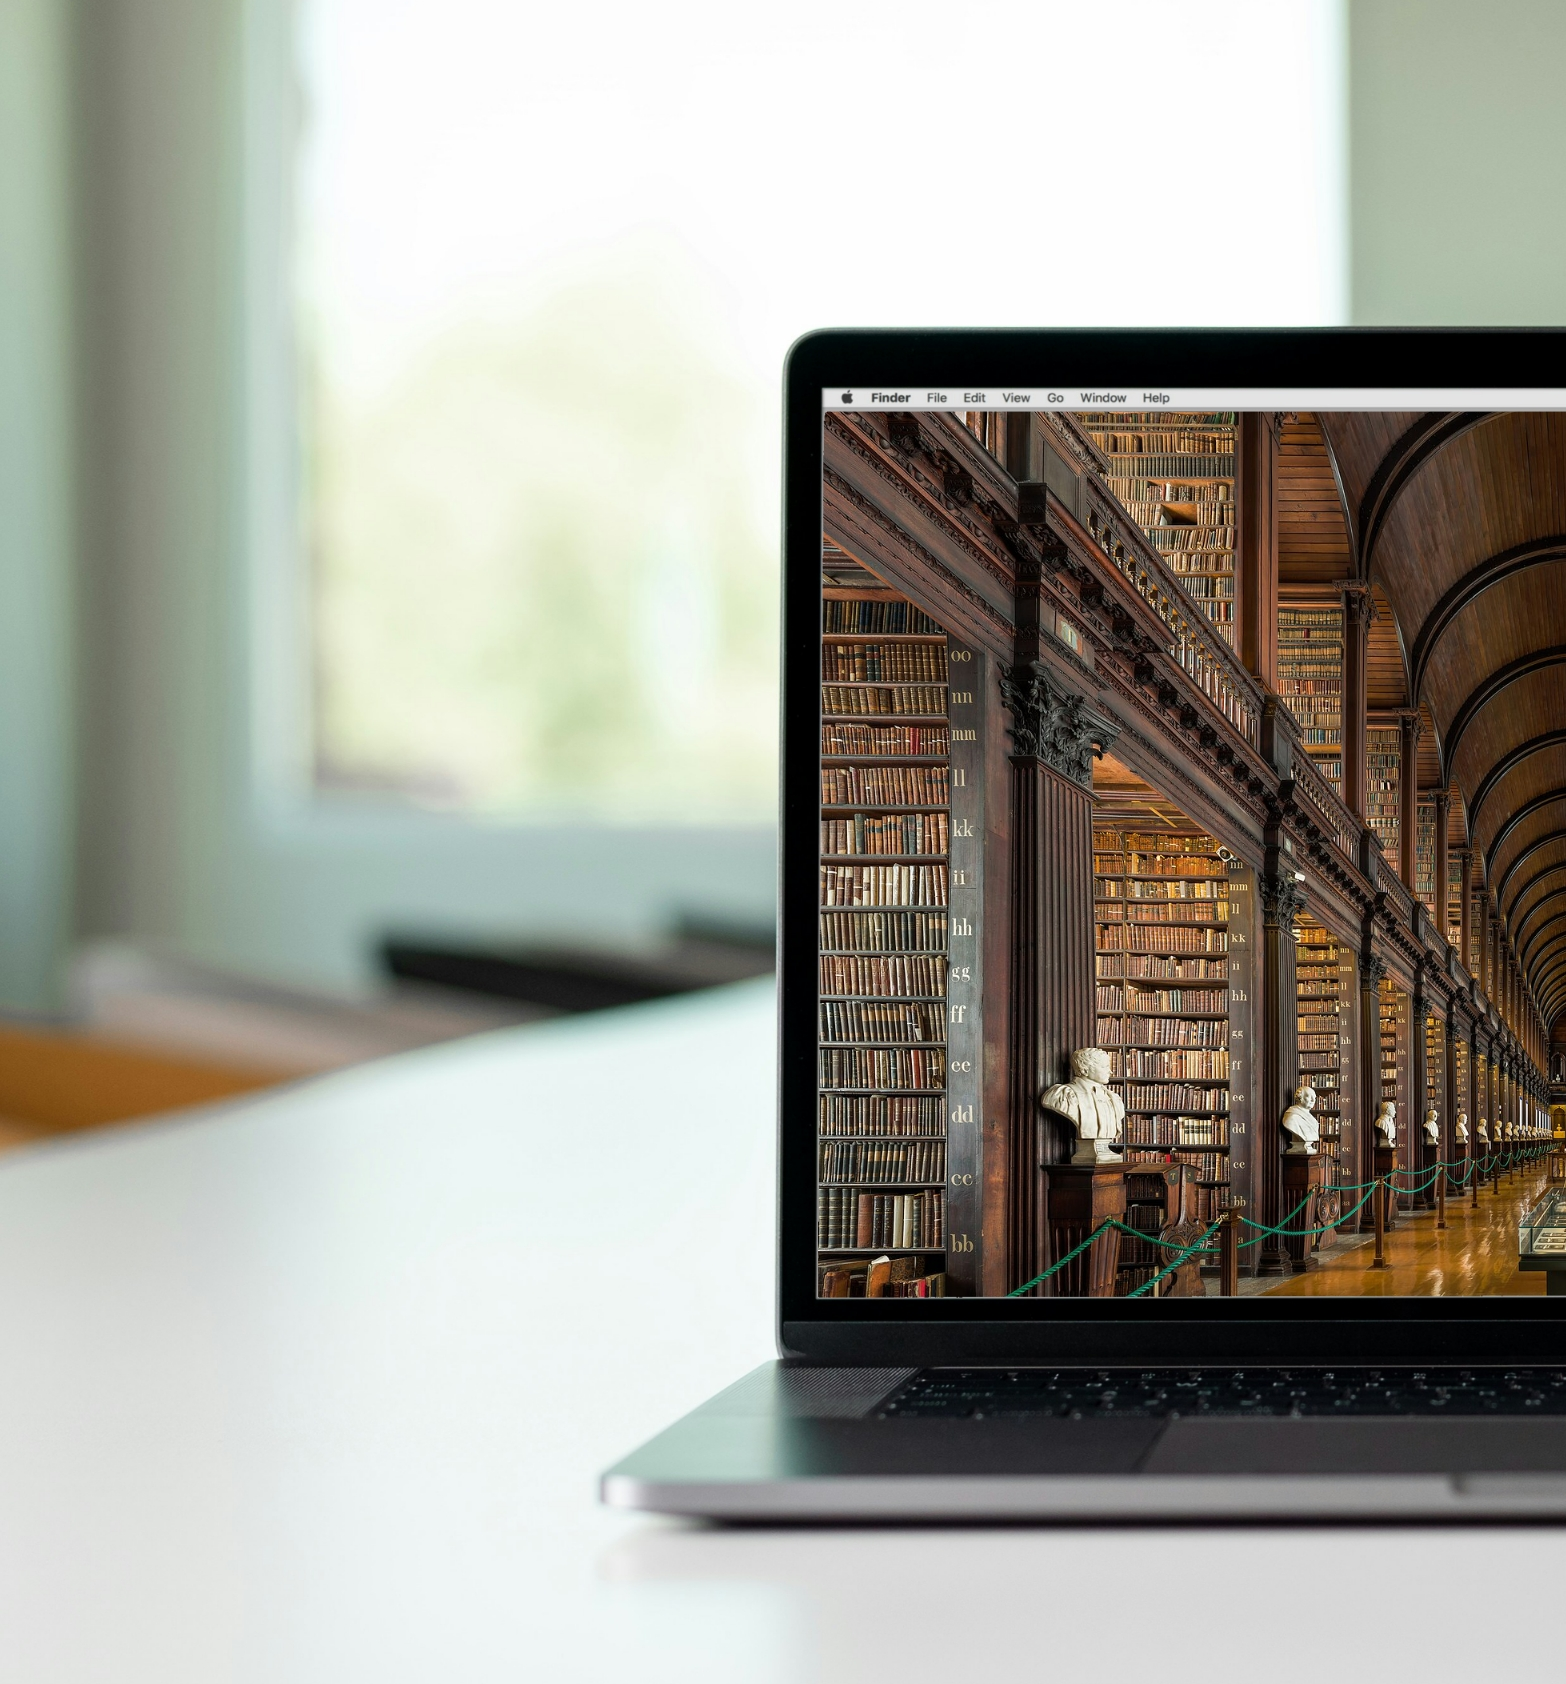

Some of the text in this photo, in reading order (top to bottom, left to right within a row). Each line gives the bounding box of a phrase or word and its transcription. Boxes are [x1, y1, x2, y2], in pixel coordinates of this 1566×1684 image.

[871, 393, 1171, 406] Finder File Edit View Go Window Help
[951, 649, 971, 663] oo
[952, 690, 973, 704] nn
[951, 728, 977, 742] mm
[952, 819, 974, 837] kk
[953, 870, 966, 886] ii
[952, 918, 973, 937] hh
[1231, 934, 1246, 943] kk
[951, 966, 971, 982] gg
[1231, 990, 1247, 1001] hh
[950, 1005, 967, 1024] ff
[951, 1059, 971, 1073] ee
[951, 1105, 974, 1124] dd
[1232, 1123, 1246, 1134] dd
[951, 1173, 972, 1186] cc
[951, 1233, 974, 1253] bb
